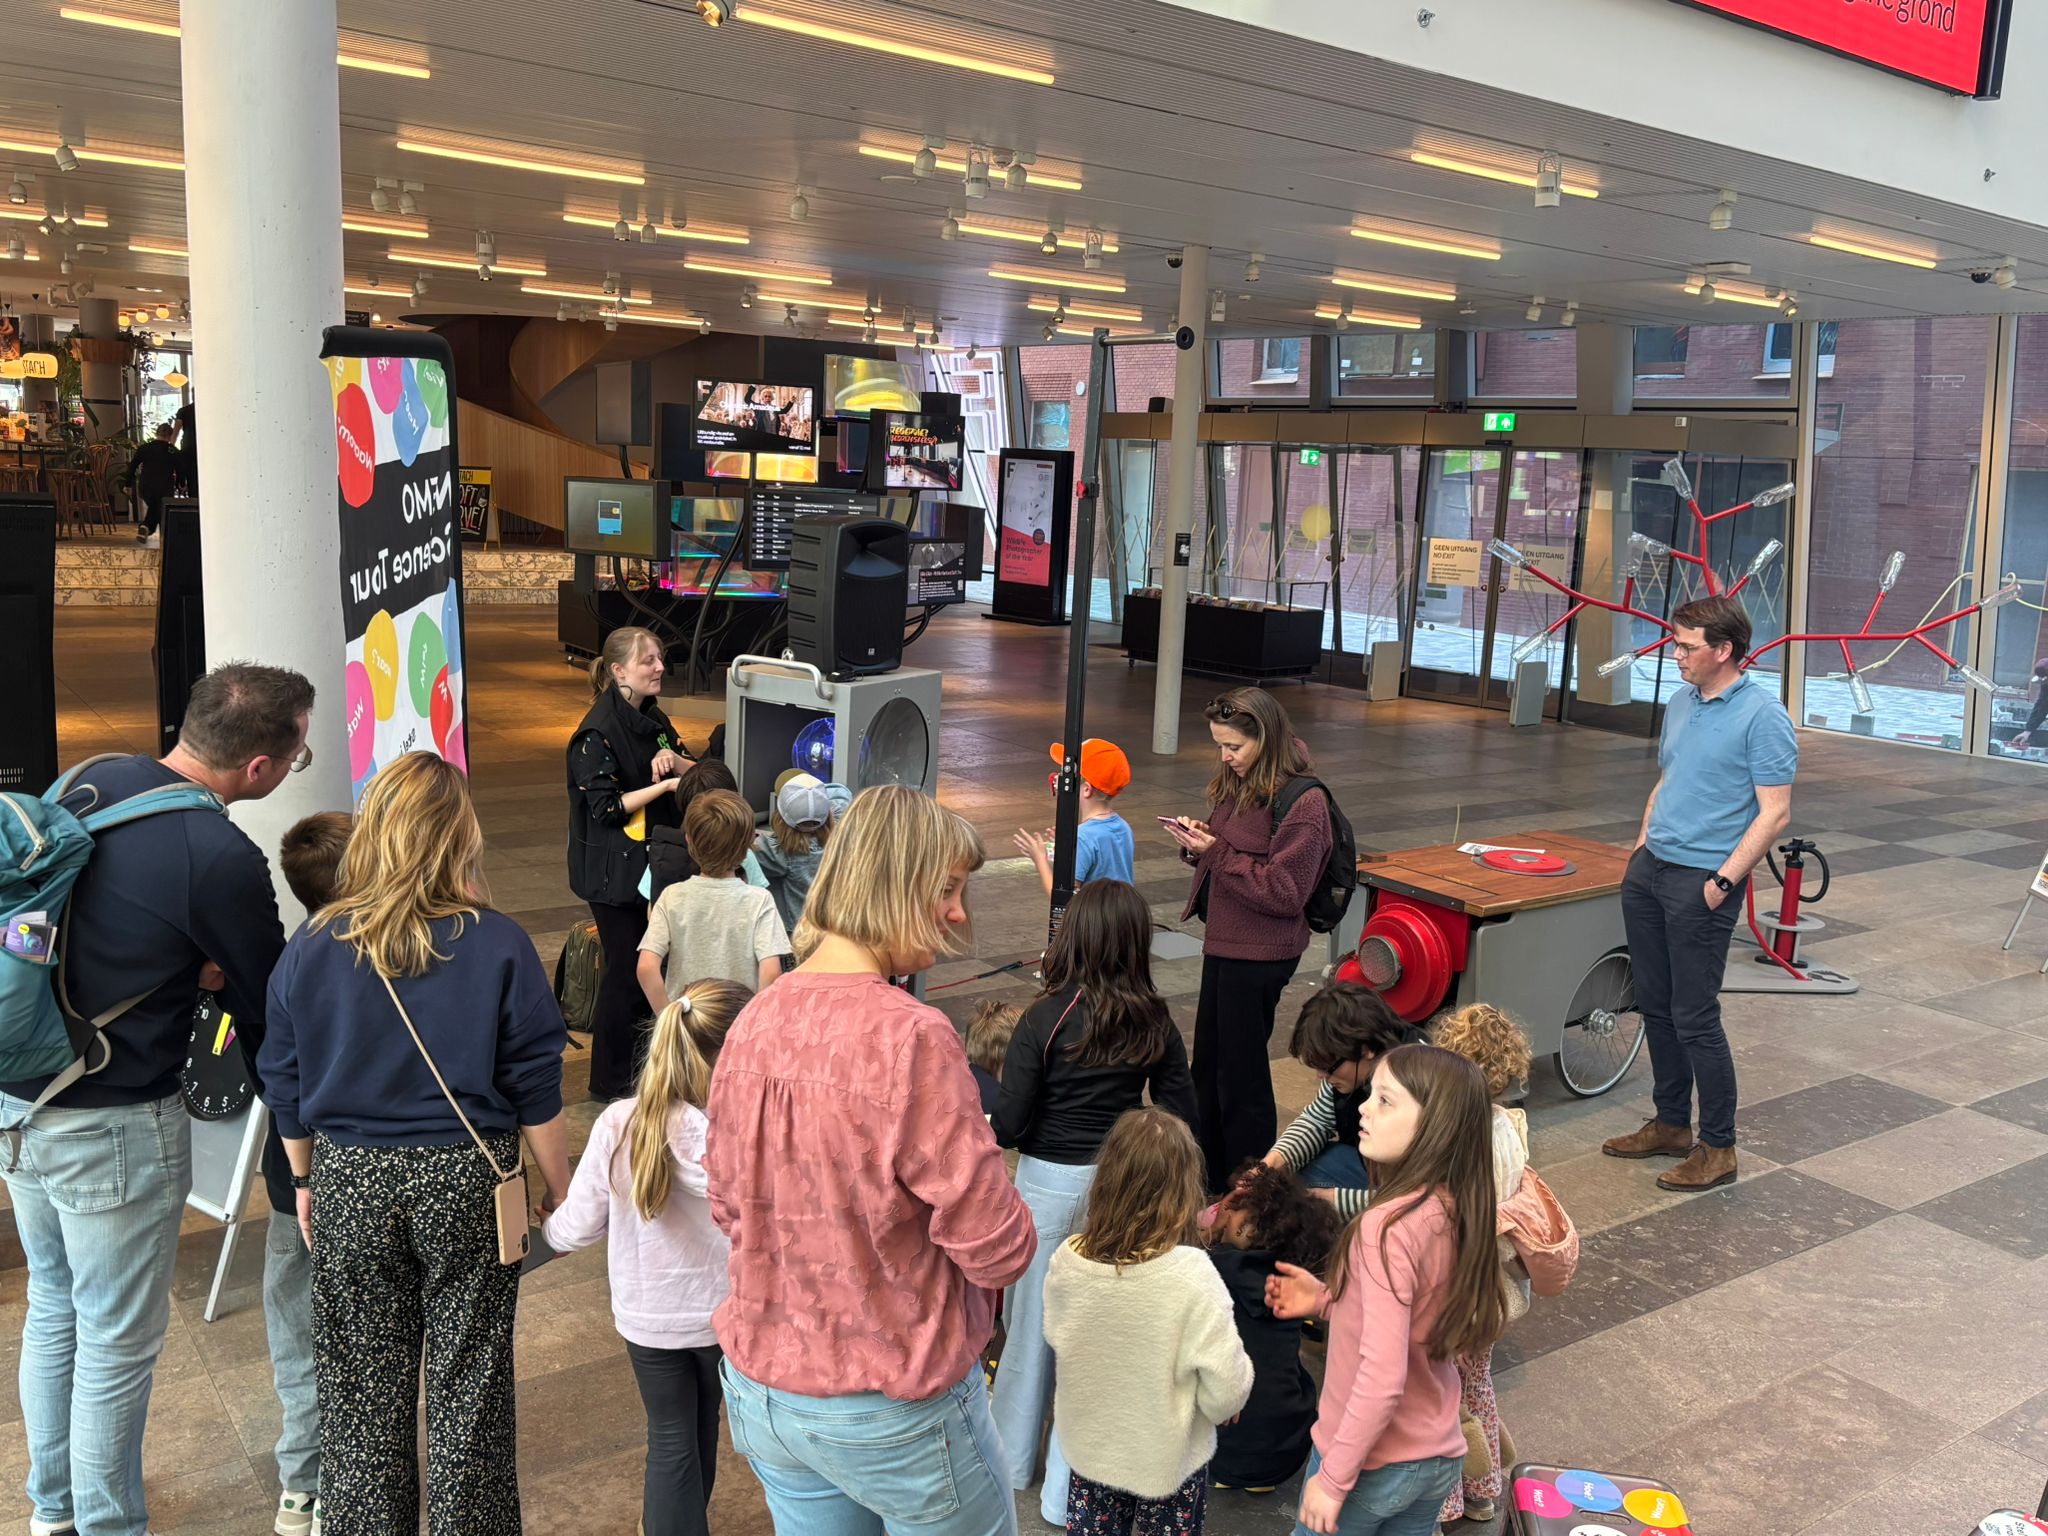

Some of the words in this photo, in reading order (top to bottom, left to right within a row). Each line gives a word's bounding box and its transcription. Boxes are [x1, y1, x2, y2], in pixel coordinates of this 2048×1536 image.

[1896, 0, 1956, 33] grond
[22, 361, 46, 375] STACH
[459, 470, 474, 482] TACH
[459, 484, 478, 506] OFT
[1433, 544, 1450, 552] GEEN
[1450, 546, 1478, 554] UITGANG
[1535, 551, 1565, 560] UITGANG
[201, 1008, 209, 1020] 10
[186, 1057, 193, 1068] 8
[191, 1081, 199, 1092] 7
[239, 1082, 246, 1093] 4
[204, 1096, 210, 1107] 6
[221, 1096, 229, 1107] 5
